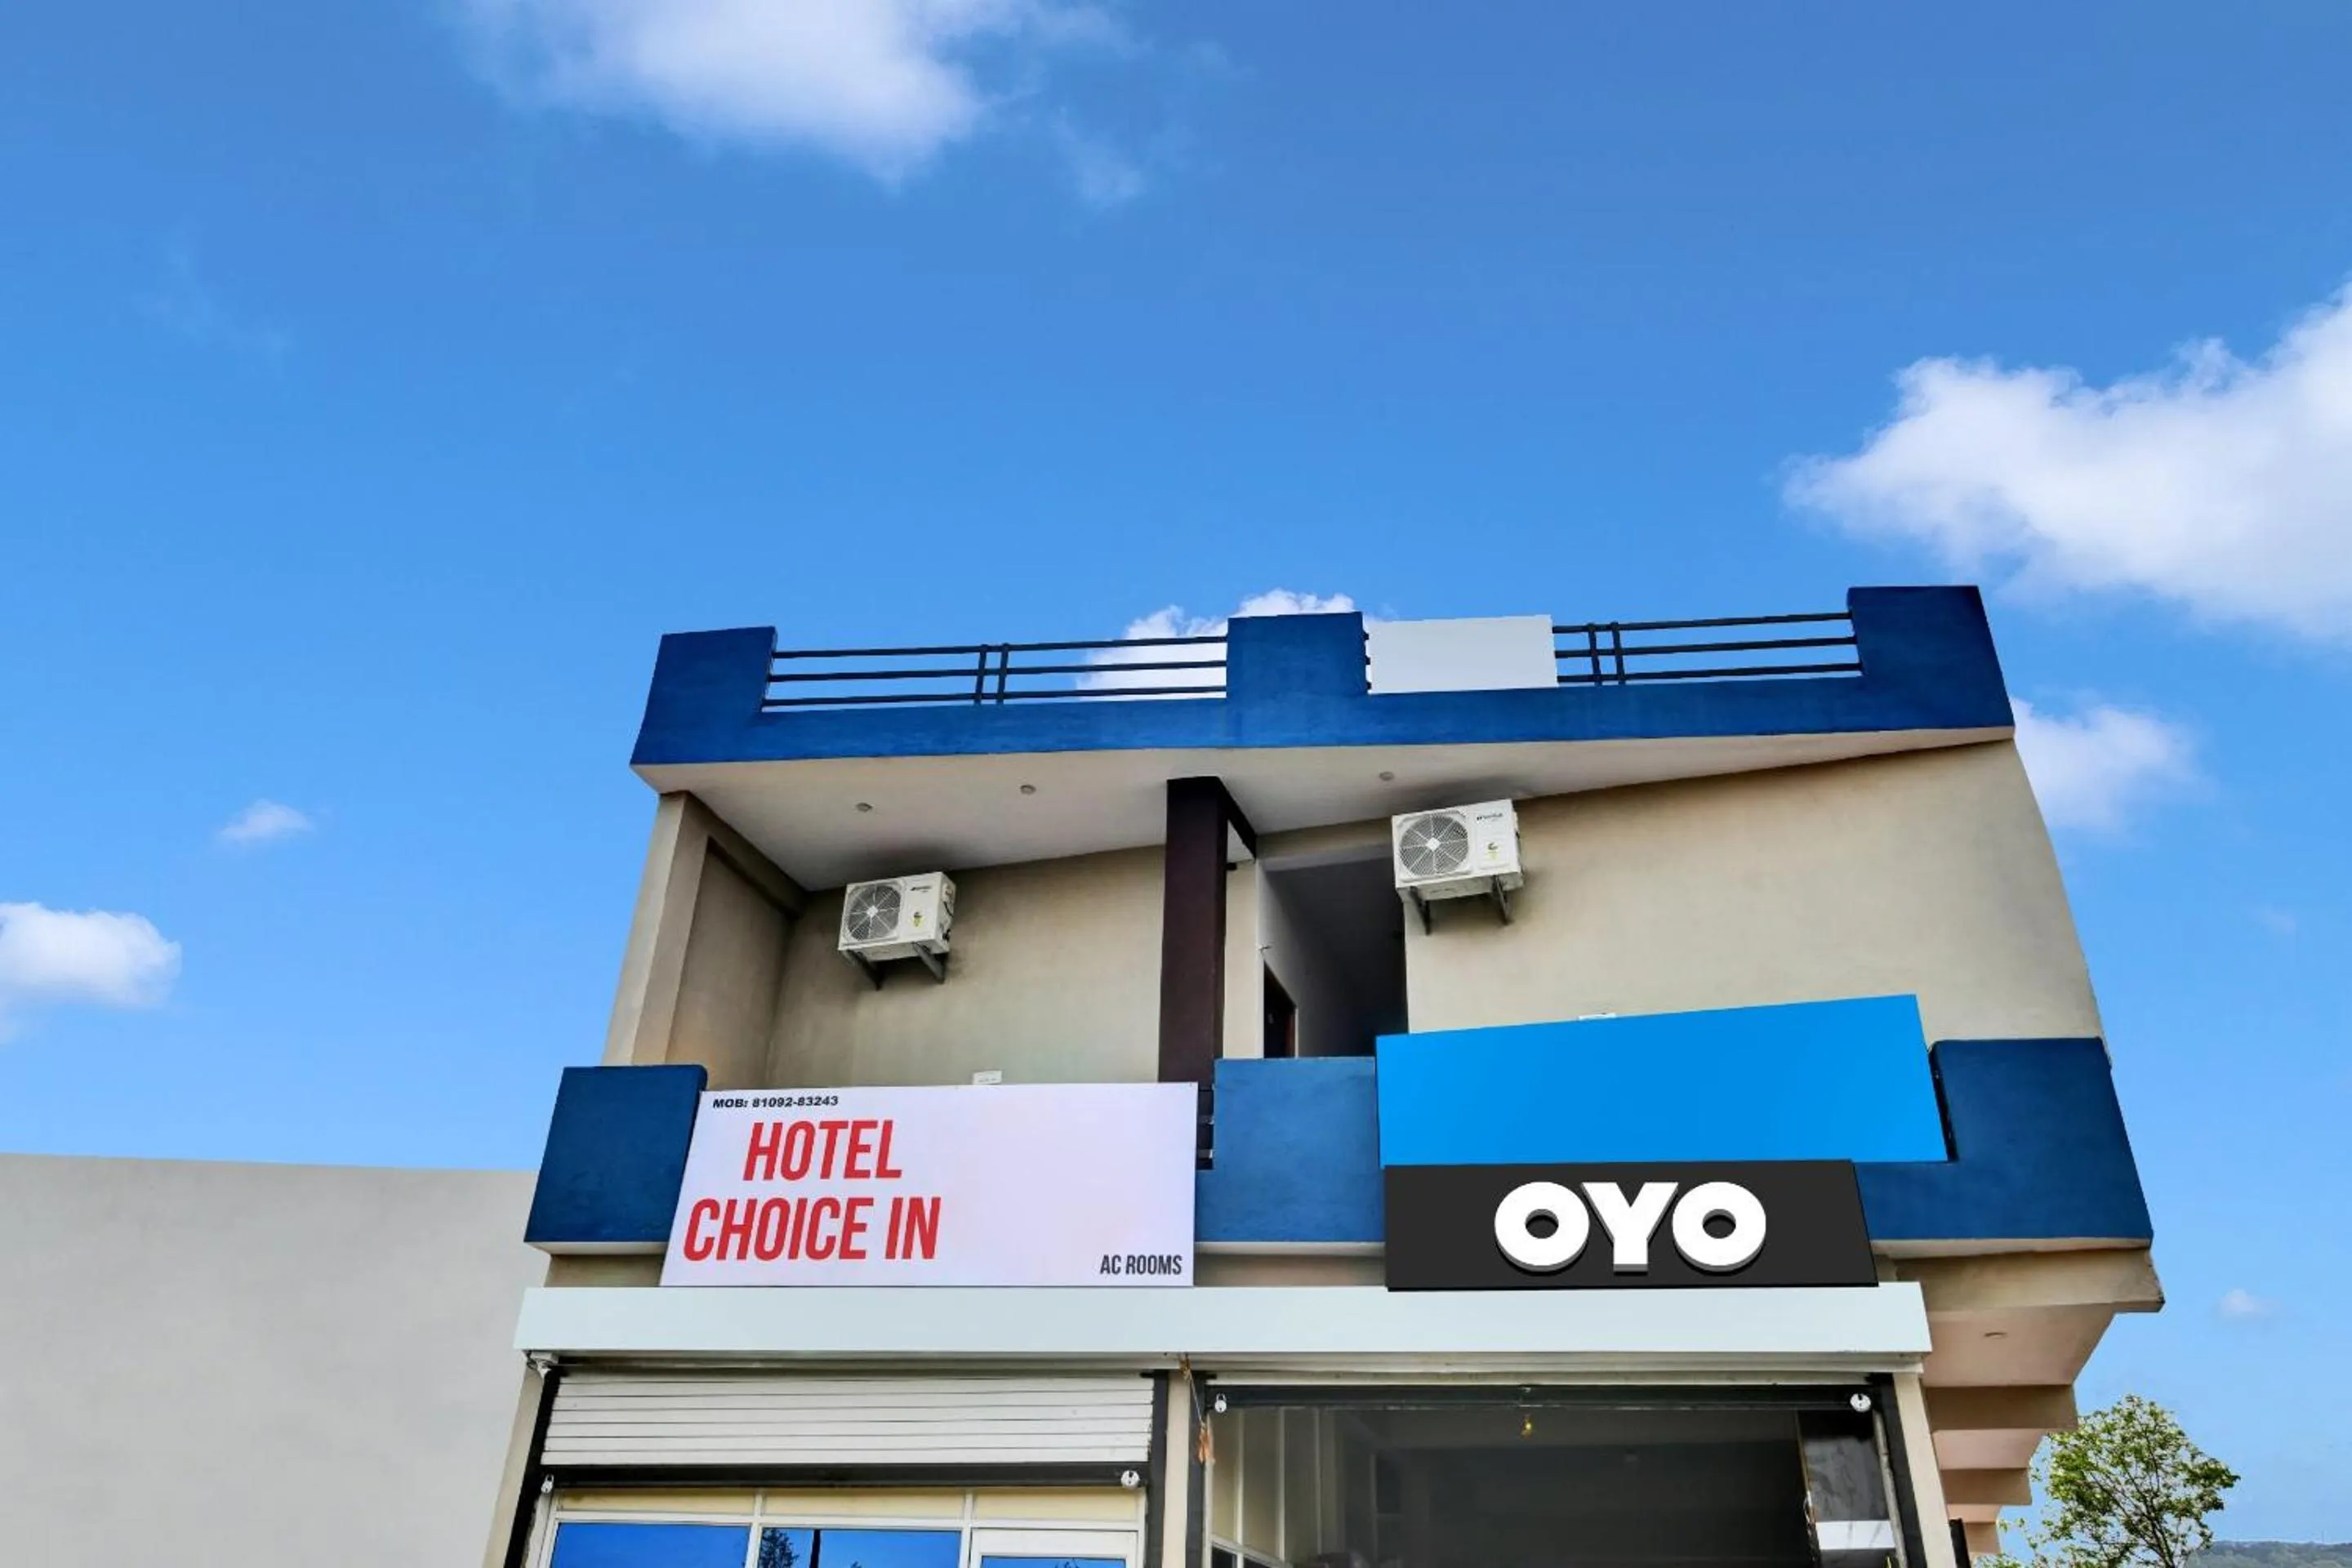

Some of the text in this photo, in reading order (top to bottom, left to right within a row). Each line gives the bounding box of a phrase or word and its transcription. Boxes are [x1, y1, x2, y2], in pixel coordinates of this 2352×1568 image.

[712, 1095, 839, 1109] MOB: 81092-83243
[742, 1119, 902, 1182] HOTEL
[683, 1196, 942, 1262] CHOICE IN
[1494, 1181, 1767, 1273] OYO
[1100, 1254, 1183, 1275] AC ROOMS
